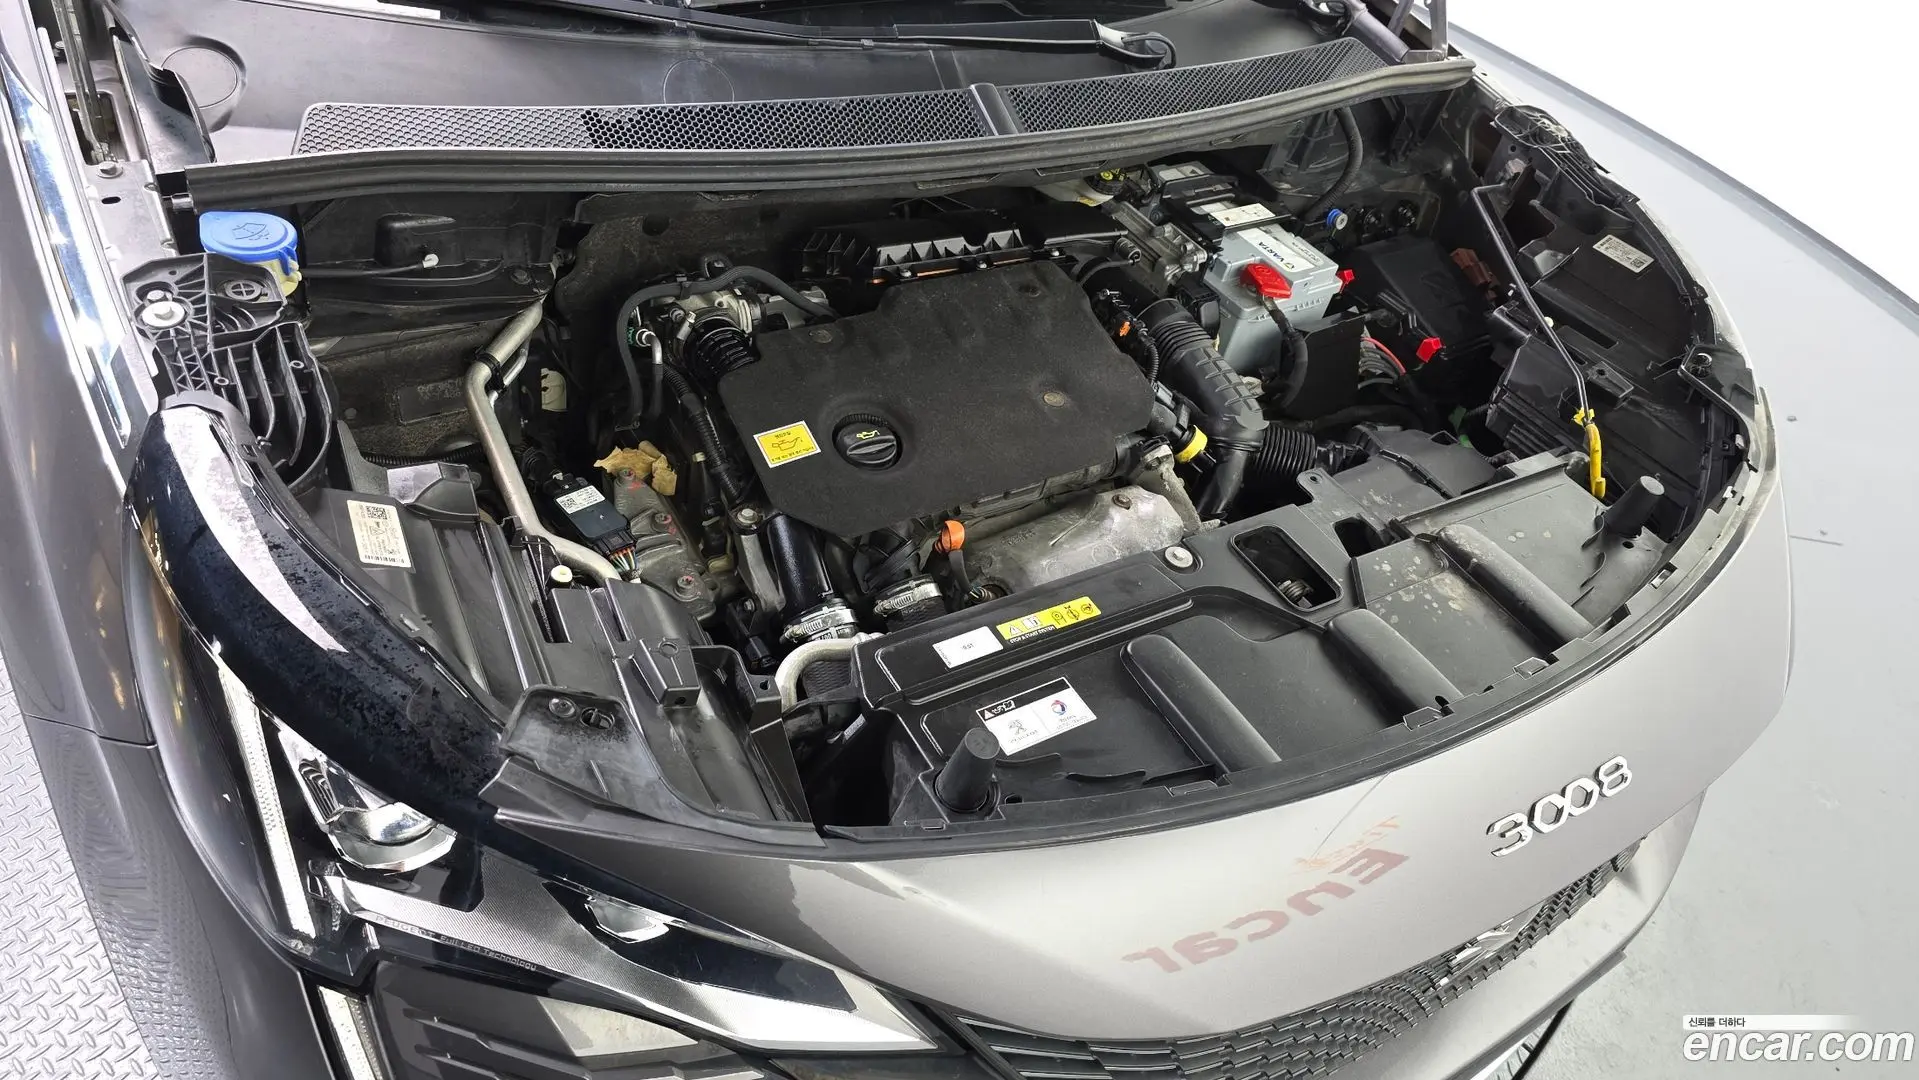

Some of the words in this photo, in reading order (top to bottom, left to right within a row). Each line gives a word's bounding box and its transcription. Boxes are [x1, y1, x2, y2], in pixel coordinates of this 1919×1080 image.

[1258, 241, 1286, 264] VARTA
[1486, 755, 1633, 857] 3008
[375, 915, 435, 938] PEUGEOT
[440, 935, 459, 947] Full
[460, 941, 481, 953] LED
[483, 948, 538, 972] Technology
